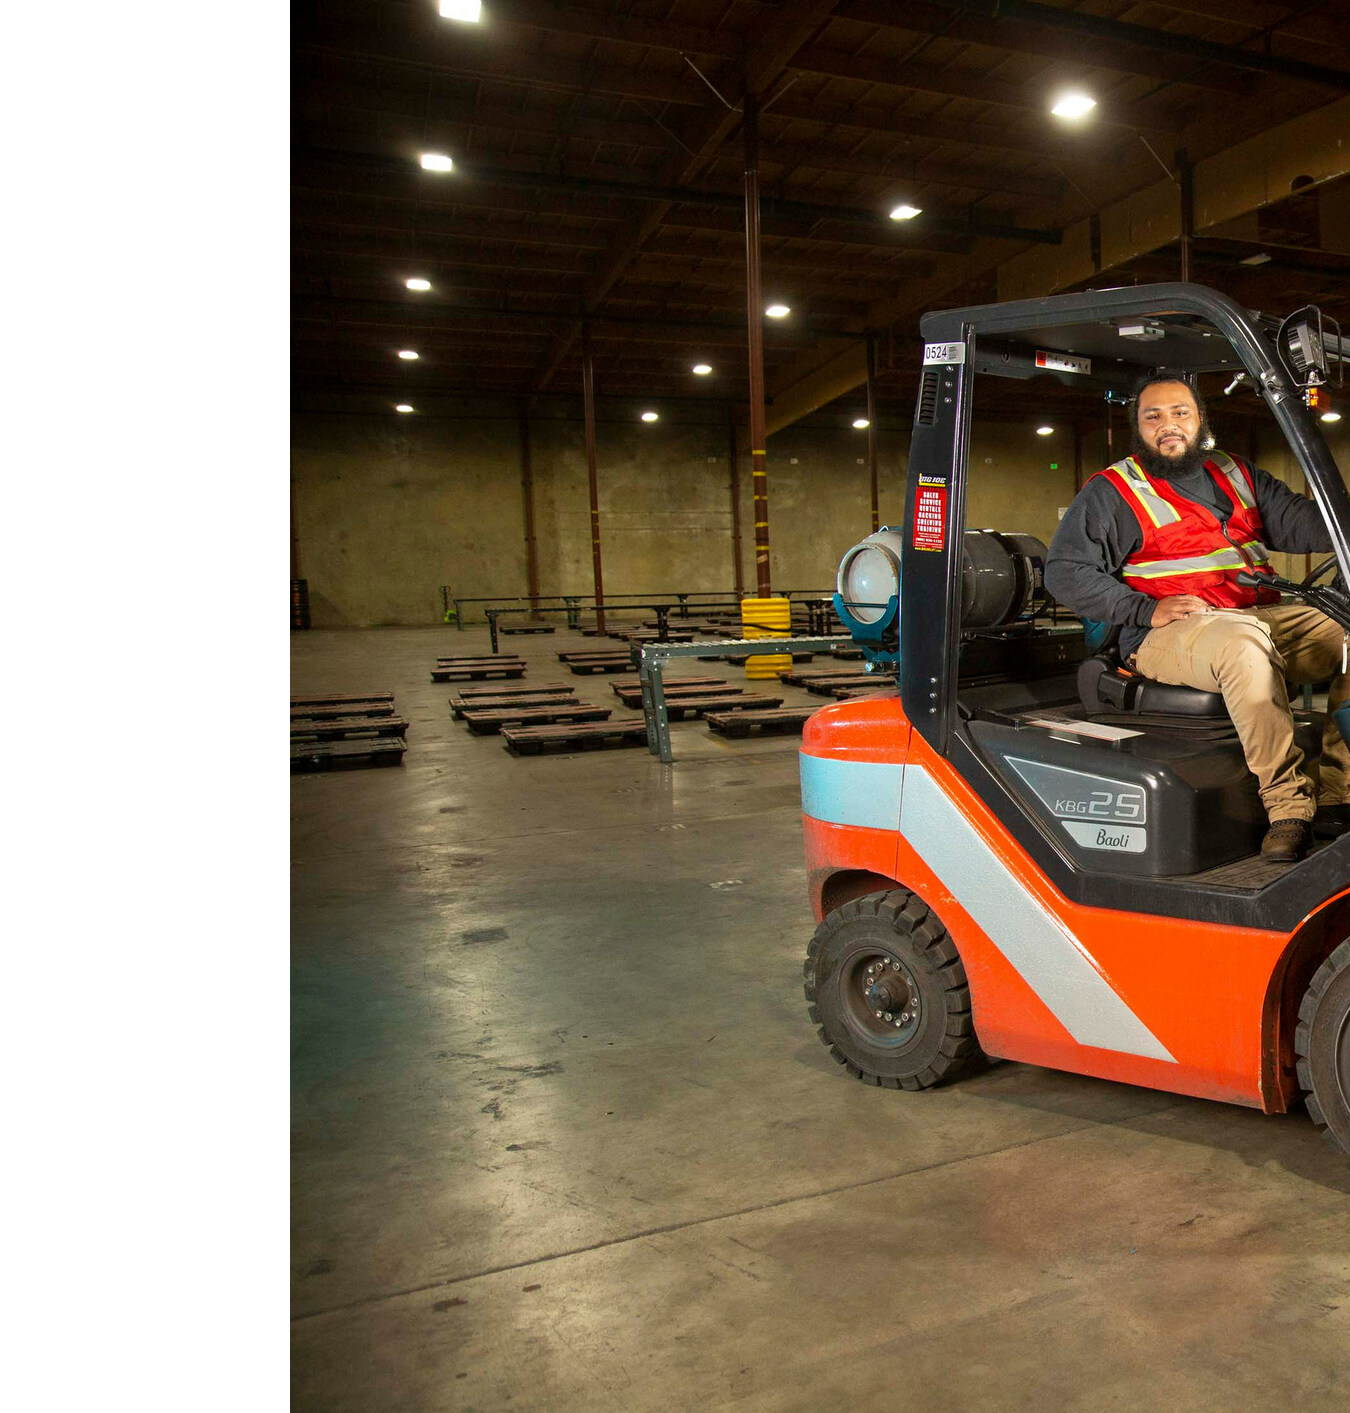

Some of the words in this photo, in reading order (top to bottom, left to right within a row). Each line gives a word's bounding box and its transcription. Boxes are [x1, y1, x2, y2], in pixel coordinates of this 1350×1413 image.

[926, 346, 947, 359] 0524
[920, 498, 941, 506] SERVICE
[917, 518, 942, 526] SHELVING
[917, 525, 942, 533] TRAINING
[1096, 828, 1130, 848] Baoli
